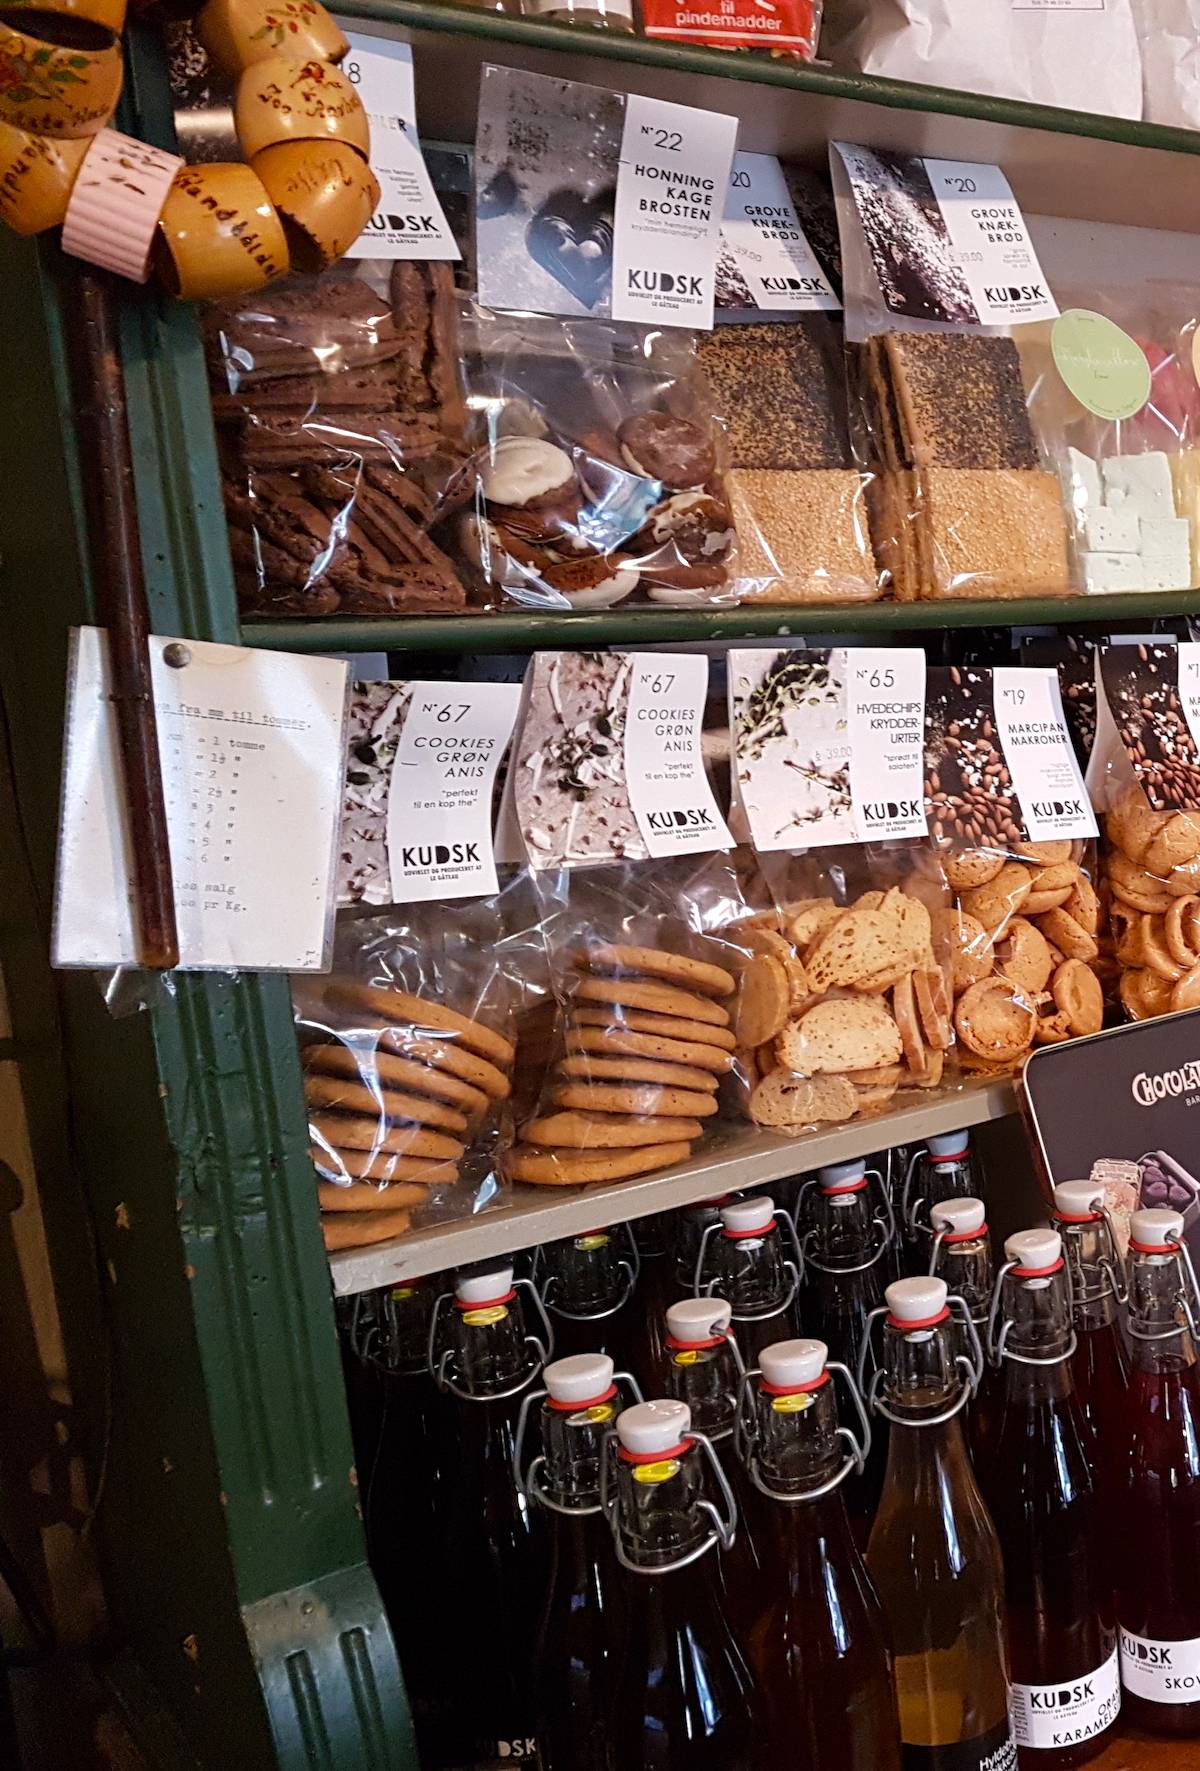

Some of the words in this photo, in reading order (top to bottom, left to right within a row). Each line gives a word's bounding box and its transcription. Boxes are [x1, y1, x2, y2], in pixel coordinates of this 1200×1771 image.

[675, 11, 782, 31] pindemadder
[634, 164, 715, 190] HONNING
[731, 171, 752, 189] 20
[667, 187, 713, 206] KAGE
[639, 200, 711, 221] BROSTEN
[744, 205, 791, 217] GROVE
[971, 208, 1016, 219] GROVE
[751, 218, 794, 230] KNÆK-
[979, 221, 1019, 232] KNÆK-
[762, 230, 800, 242] BRØD
[987, 233, 1024, 243] BRØD
[627, 269, 704, 296] KUDSK
[760, 277, 828, 292] KUDSK
[984, 285, 1046, 302] KUDSK
[179, 703, 201, 715] fra
[208, 708, 224, 718] mm
[232, 711, 253, 722] til
[856, 702, 922, 714] HVEDECHIPS
[637, 709, 696, 720] COOKIES
[870, 718, 921, 729] KRYDDER-
[1008, 723, 1065, 733] MARCIPAN
[655, 725, 694, 736] GRØN
[414, 737, 496, 748] COOKIES
[890, 733, 921, 744] URTER
[1011, 734, 1068, 746] MAKRONER
[229, 739, 266, 751] tomme
[664, 741, 693, 752] ANIS
[436, 753, 490, 763] GRØN
[444, 766, 485, 778] ANIS
[665, 772, 678, 782] kop
[438, 800, 455, 810] kop
[863, 800, 921, 820] KUDSK
[1031, 800, 1085, 817] KUDSK
[646, 809, 714, 830] KUDSK
[402, 843, 480, 867] KUDSK
[1121, 1633, 1172, 1665] KUDSK
[1030, 1680, 1094, 1709] KUDSK
